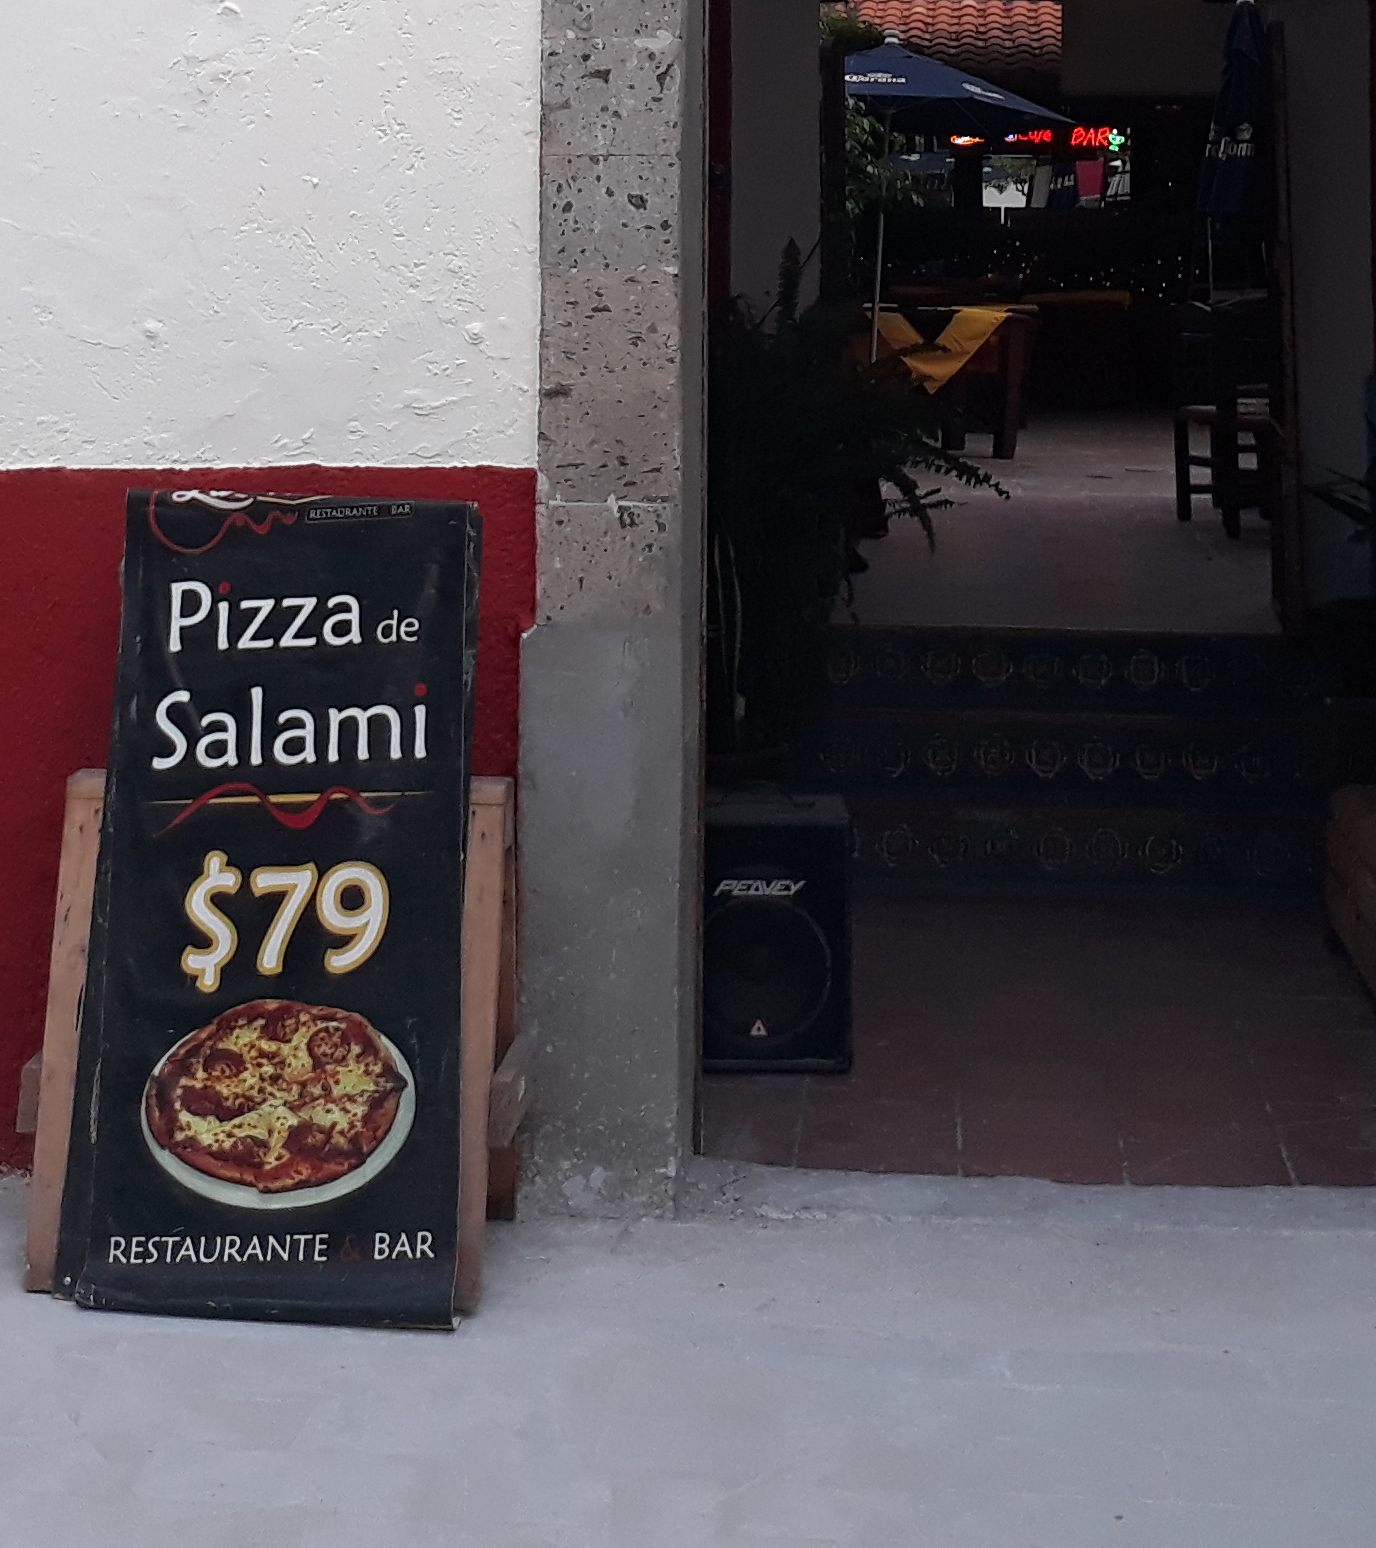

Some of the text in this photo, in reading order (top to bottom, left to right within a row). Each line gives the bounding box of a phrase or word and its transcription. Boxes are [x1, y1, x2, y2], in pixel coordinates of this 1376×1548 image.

[1070, 126, 1111, 147] BAR
[309, 503, 412, 520] RESTAURANTE BAR
[169, 580, 421, 654] Pizza de
[150, 683, 429, 772] Salami
[712, 877, 808, 897] PEAVEY
[181, 851, 390, 993] $79
[107, 1232, 330, 1264] RESTAURANTE
[373, 1230, 436, 1261] BAR
